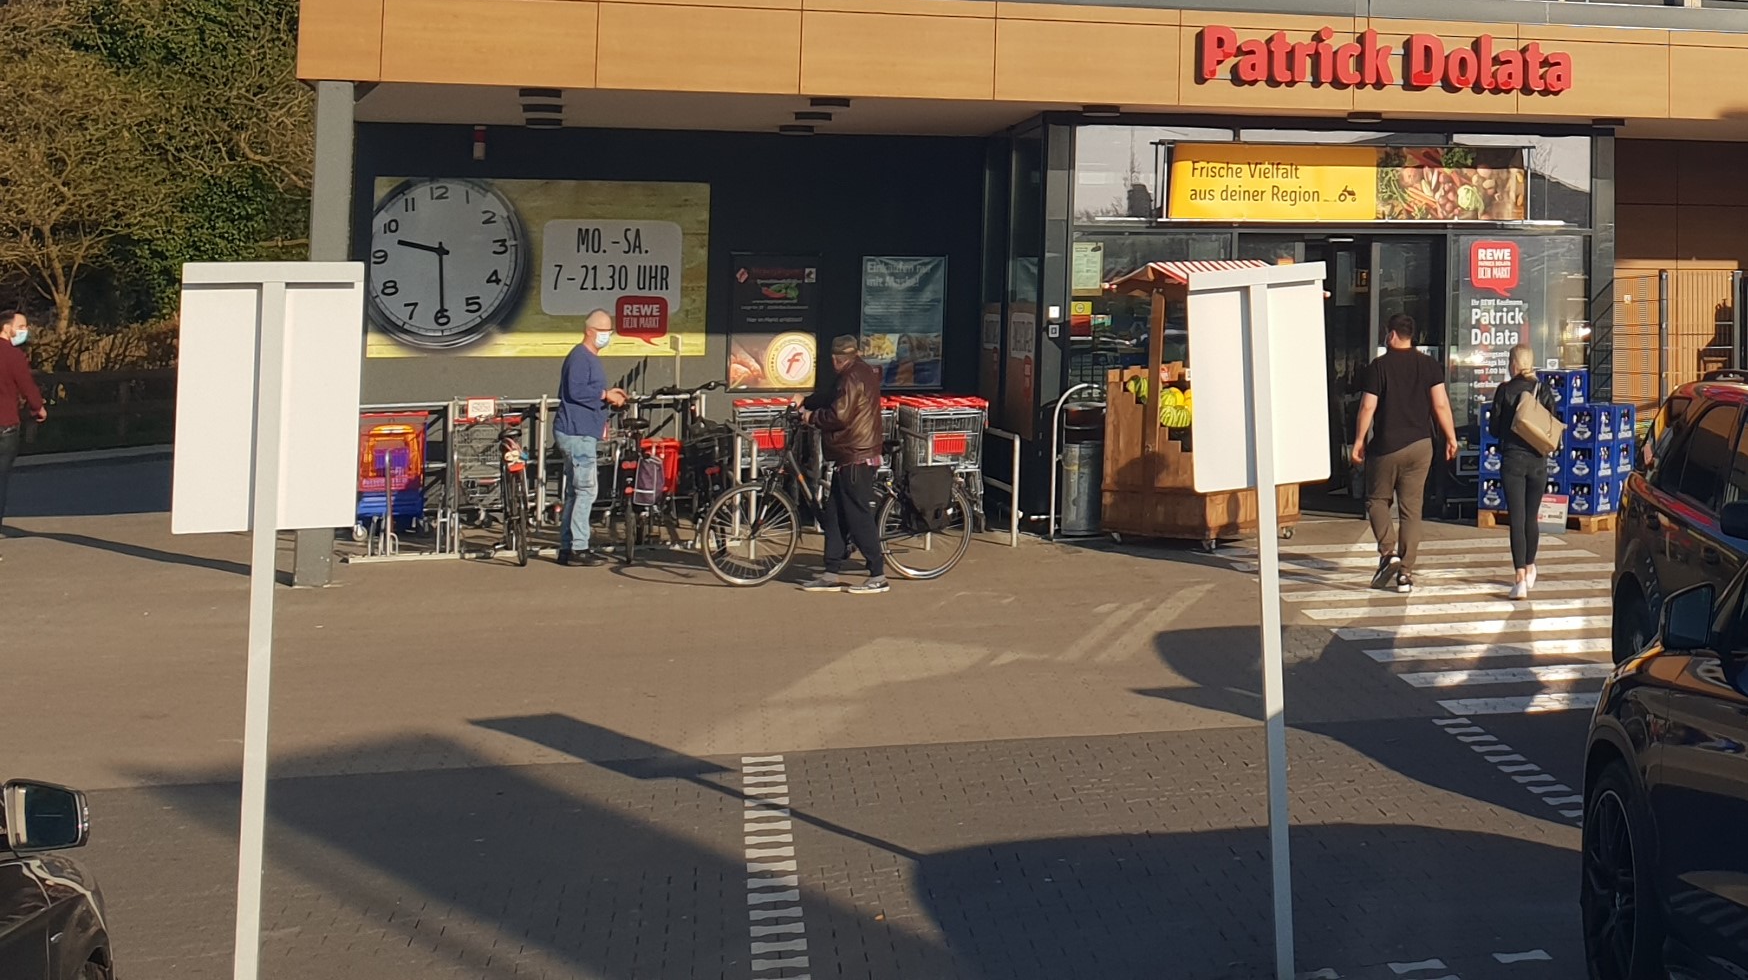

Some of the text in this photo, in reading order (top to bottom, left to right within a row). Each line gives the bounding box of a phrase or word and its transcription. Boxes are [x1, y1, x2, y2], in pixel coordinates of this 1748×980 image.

[1199, 24, 1573, 94] Patrick Dolata
[1191, 160, 1300, 180] Frische Vielfalt
[429, 185, 449, 201] 12
[1190, 185, 1320, 207] aus deiner Region
[404, 197, 416, 213] 11
[481, 210, 497, 225] 2
[383, 219, 399, 234] 10
[492, 238, 508, 255] 3
[1477, 248, 1511, 261] REWE
[372, 249, 389, 265] 9
[485, 269, 502, 286] 4
[637, 264, 669, 291] UHR
[380, 280, 399, 297] 8
[403, 302, 419, 321] 7
[464, 295, 483, 314] 5
[623, 304, 661, 316] REWE
[433, 308, 451, 327] 6
[1471, 307, 1524, 326] Patrick
[1471, 327, 1519, 346] Dolata
